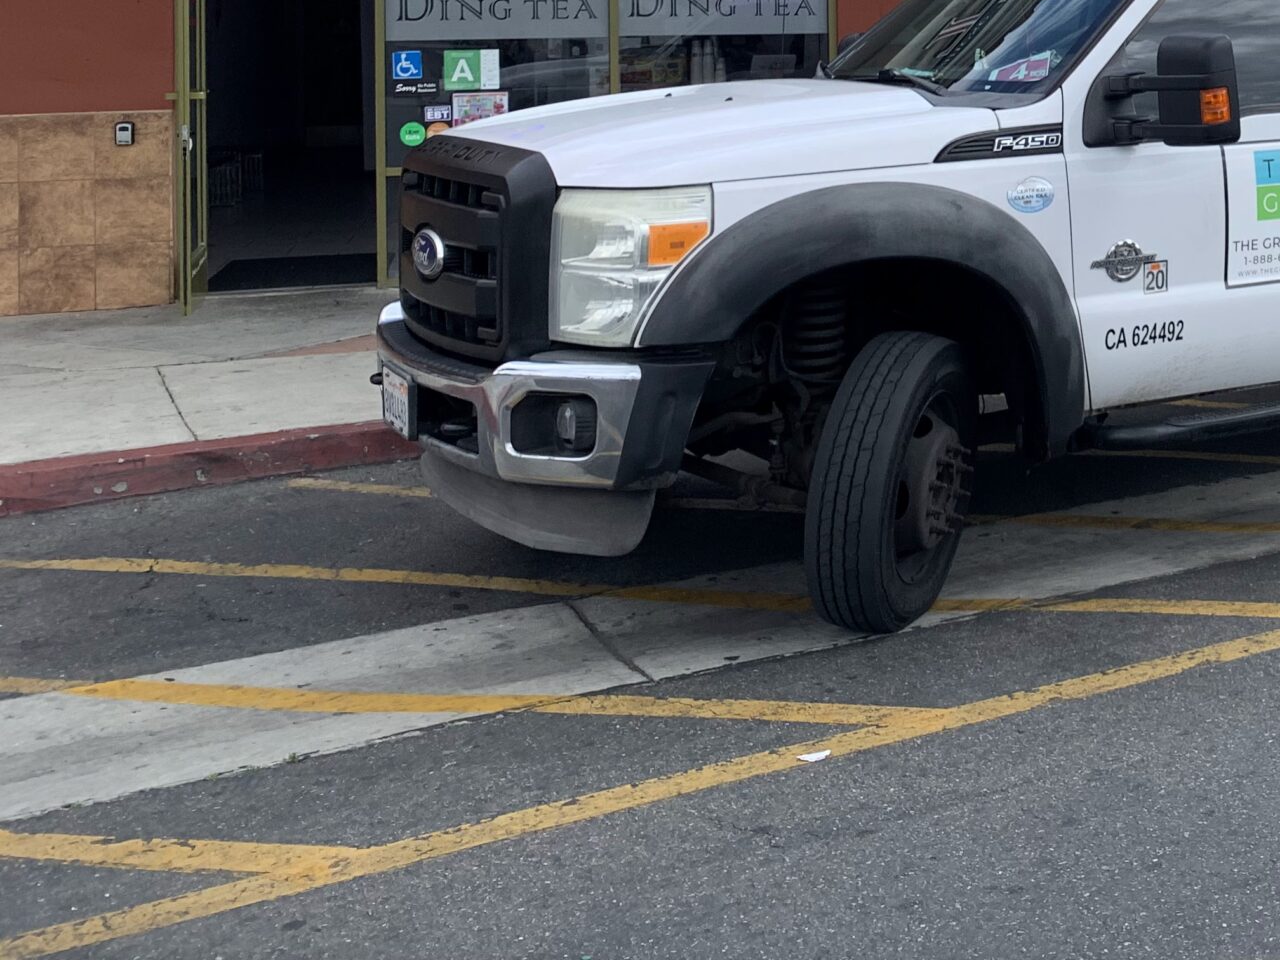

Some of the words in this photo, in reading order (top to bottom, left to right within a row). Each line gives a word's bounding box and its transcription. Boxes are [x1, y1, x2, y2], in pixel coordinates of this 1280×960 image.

[450, 58, 475, 82] A
[395, 83, 417, 94] Sorry
[427, 110, 449, 120] EBT
[993, 132, 1062, 152] F-450
[1232, 238, 1259, 253] THE
[1145, 269, 1165, 291] 20
[1104, 326, 1127, 351] CA
[1131, 319, 1184, 347] 624492
